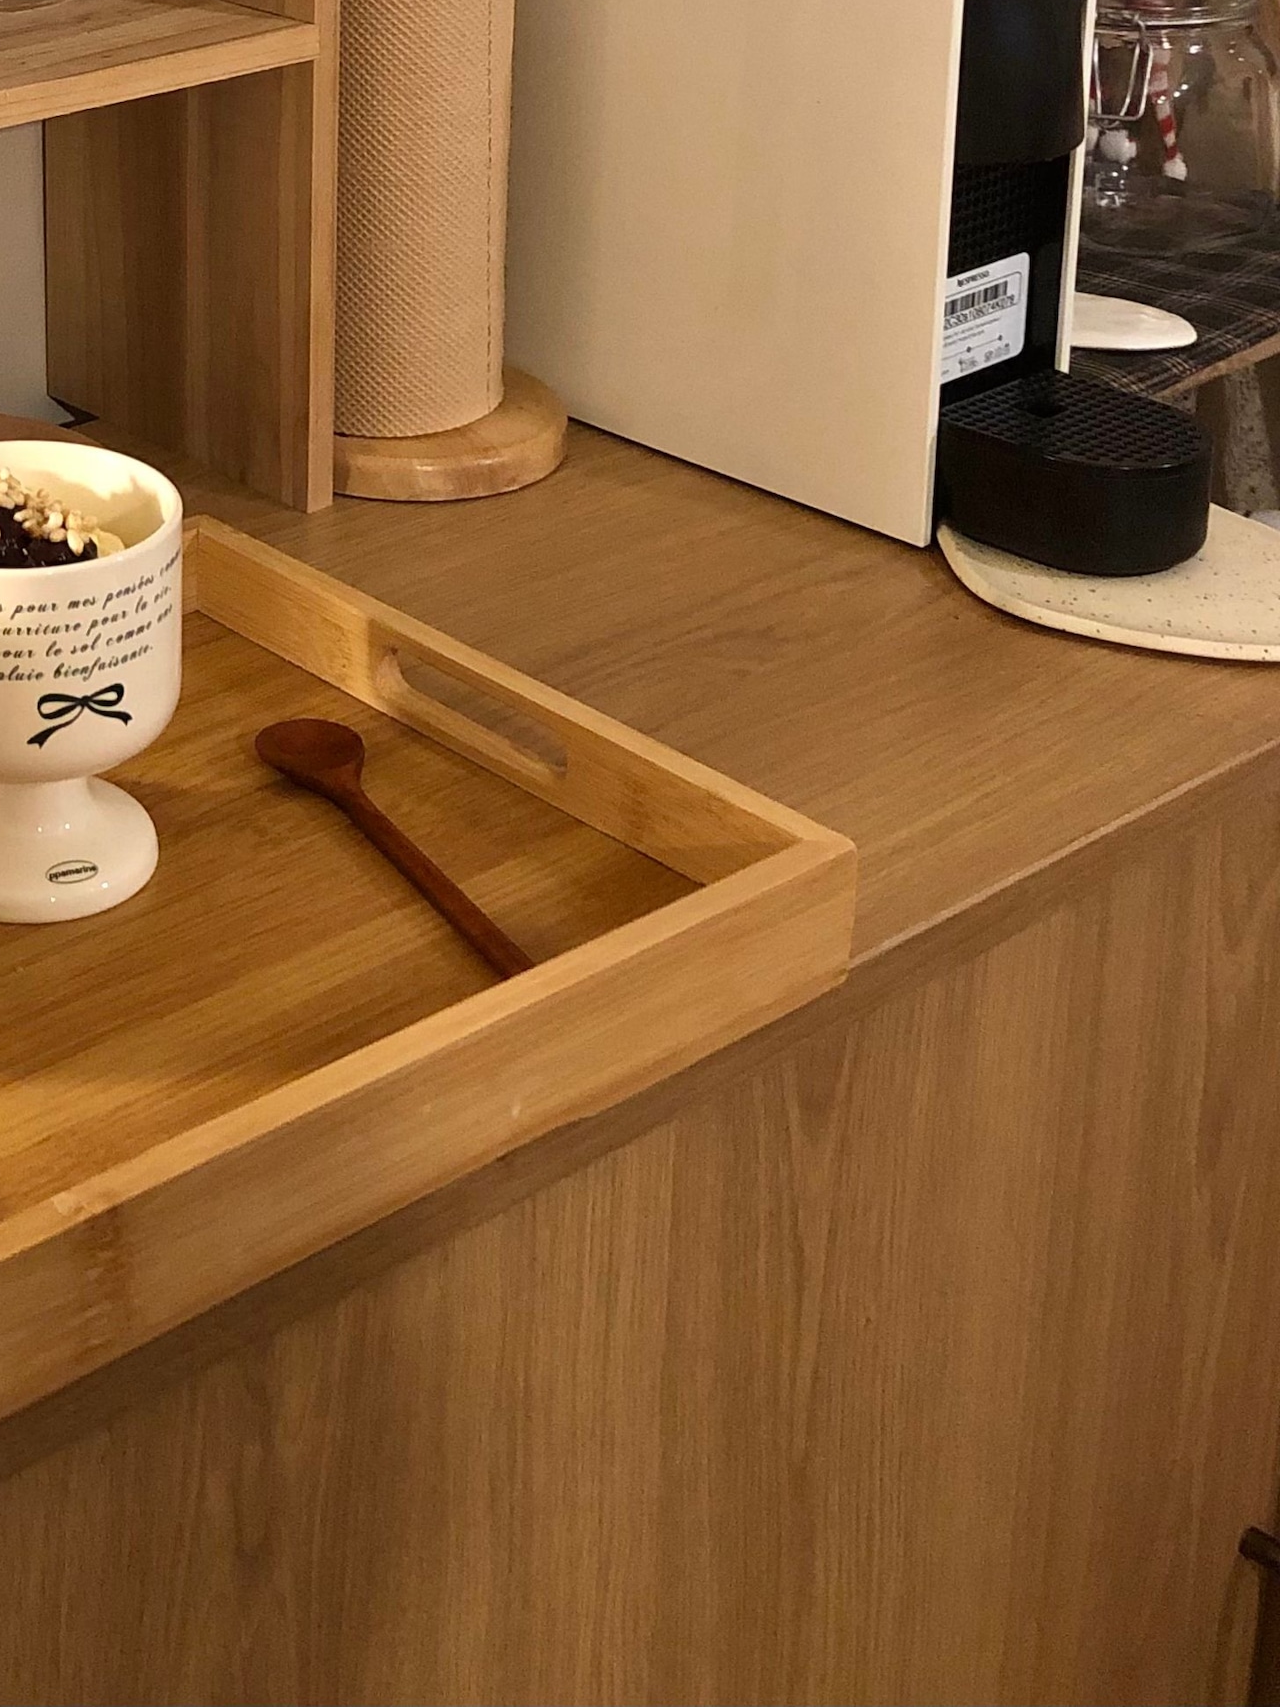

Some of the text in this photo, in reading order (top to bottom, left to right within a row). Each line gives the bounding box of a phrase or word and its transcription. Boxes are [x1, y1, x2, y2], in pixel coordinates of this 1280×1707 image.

[10, 602, 58, 620] pour
[67, 595, 97, 609] mes
[102, 574, 154, 610] pensées
[86, 610, 127, 636] pour
[135, 595, 147, 614] la
[45, 641, 63, 657] le
[70, 633, 101, 655] sol
[106, 620, 152, 646] comme
[49, 865, 97, 882] ppamarine
